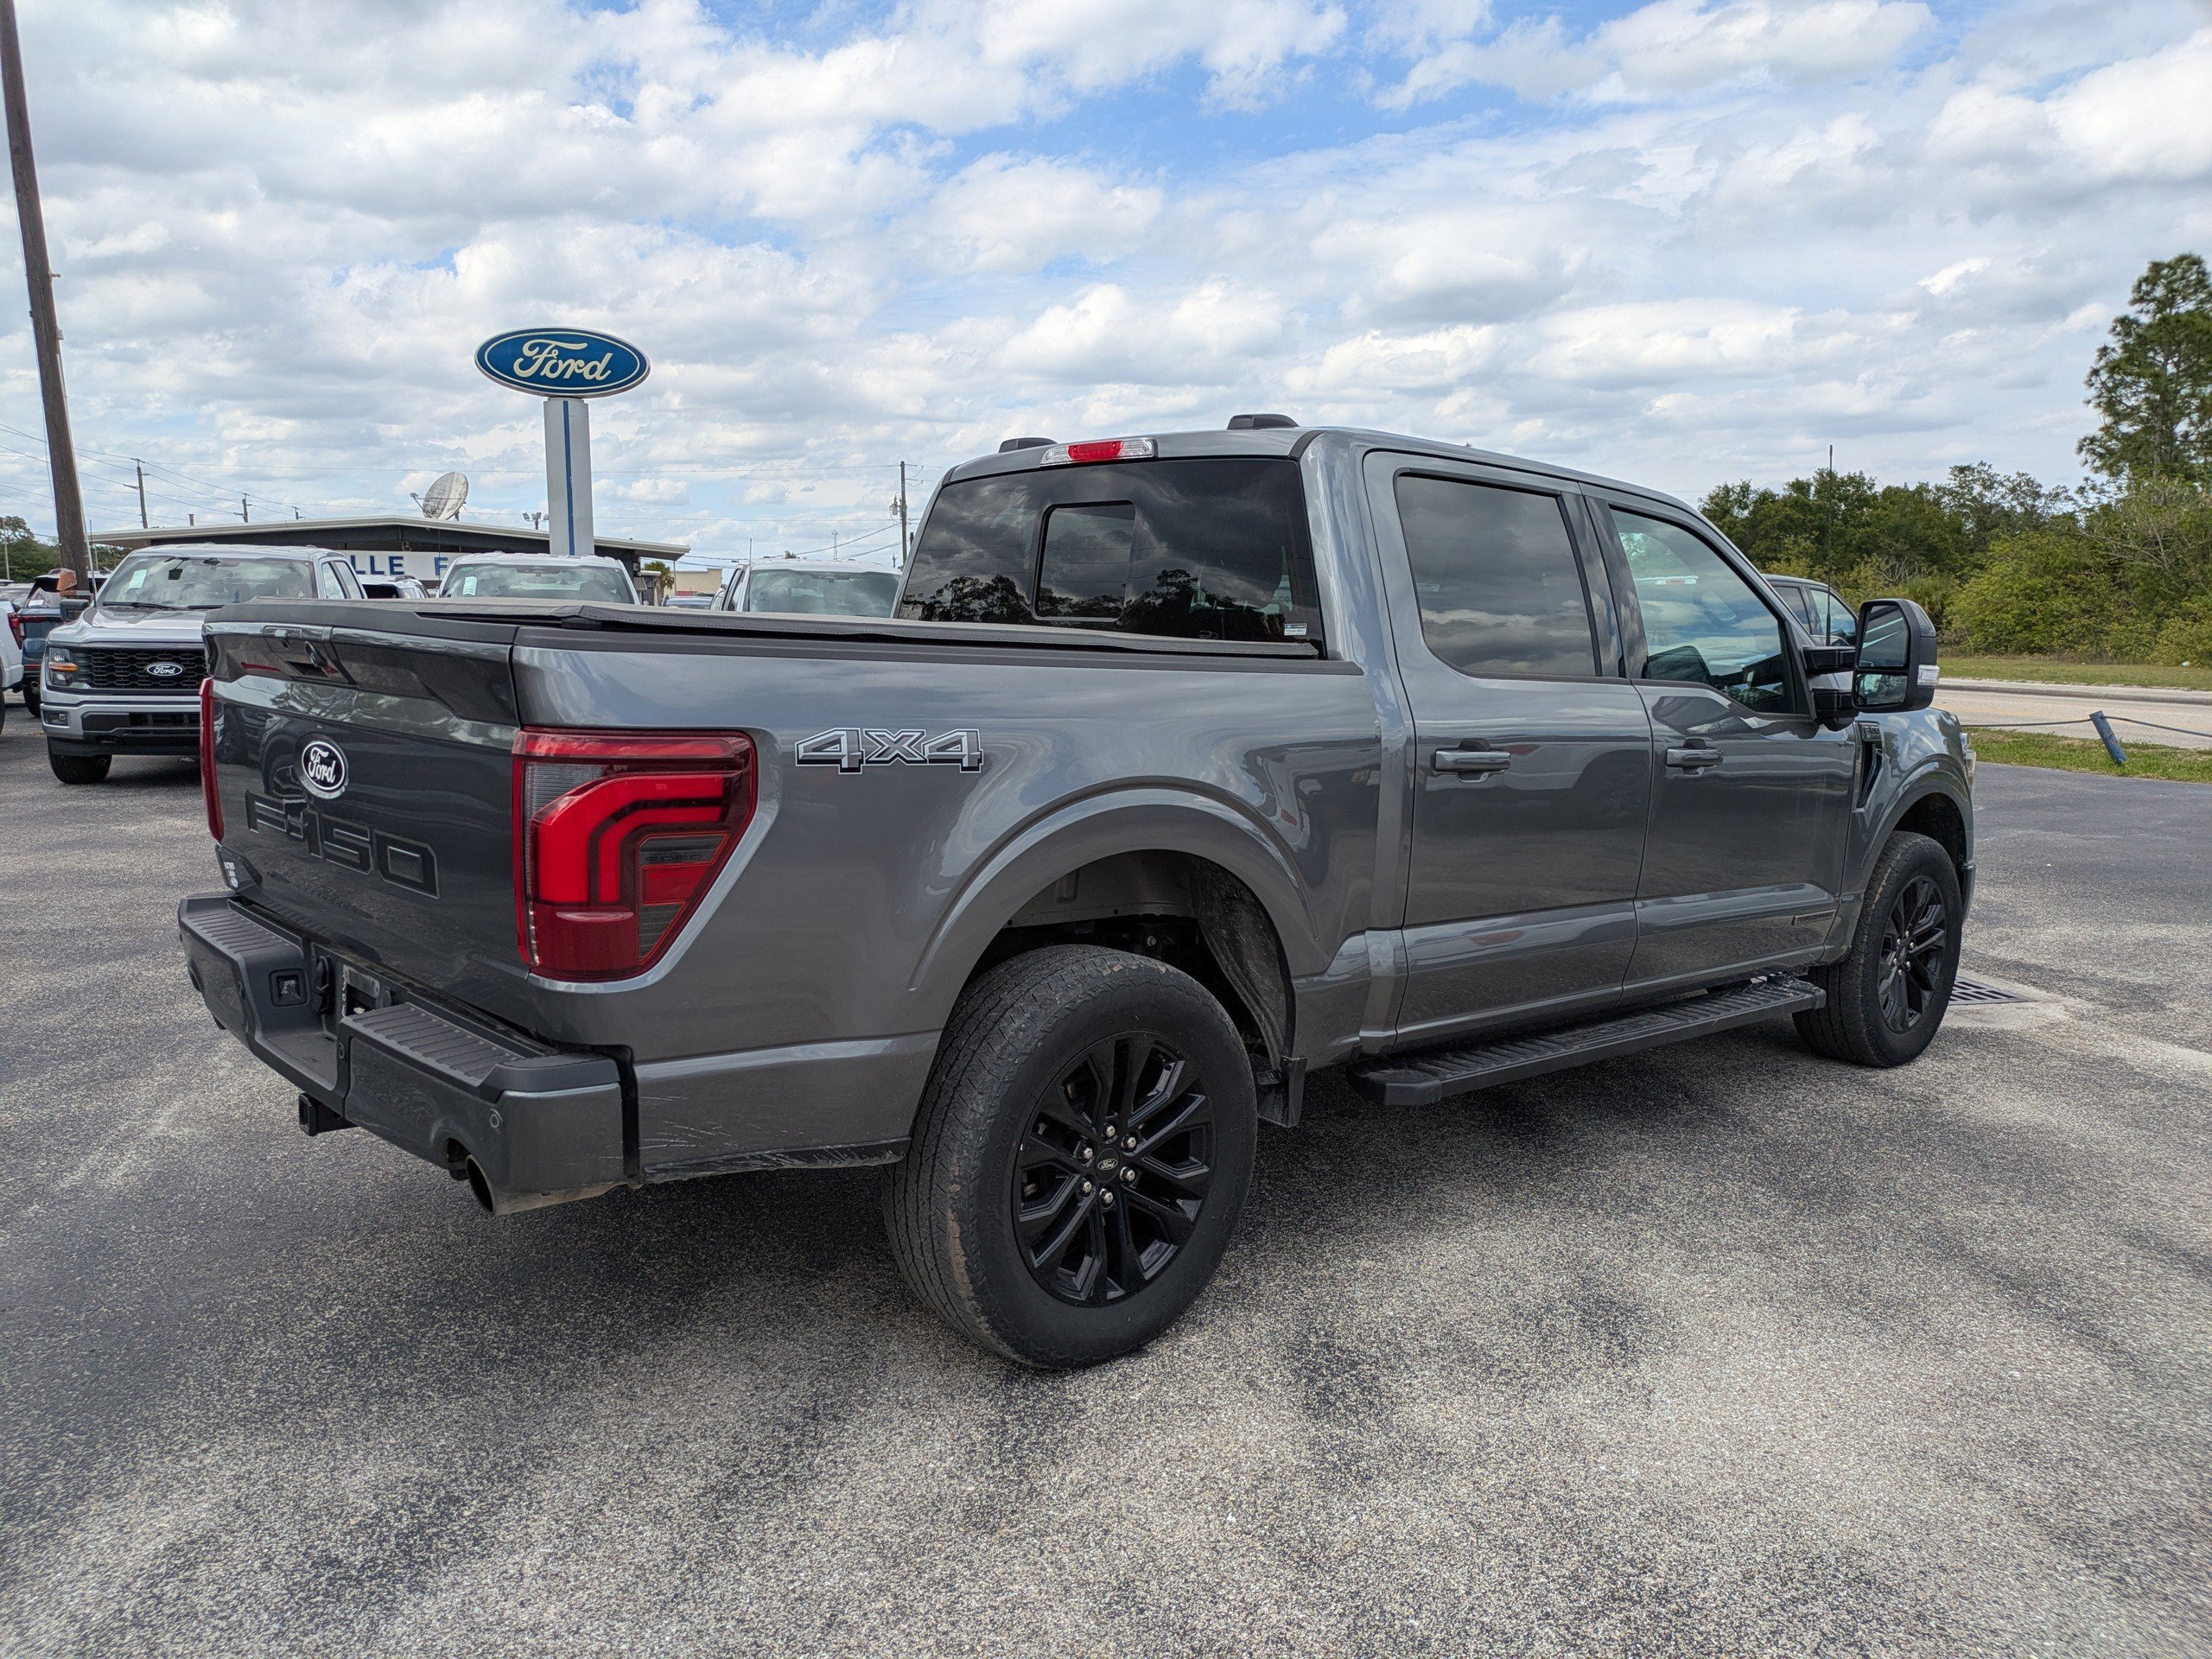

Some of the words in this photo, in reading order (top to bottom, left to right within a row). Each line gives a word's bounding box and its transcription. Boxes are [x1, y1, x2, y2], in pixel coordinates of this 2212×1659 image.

[513, 339, 613, 381] Ford
[153, 665, 176, 674] Ford
[308, 747, 336, 784] Ford
